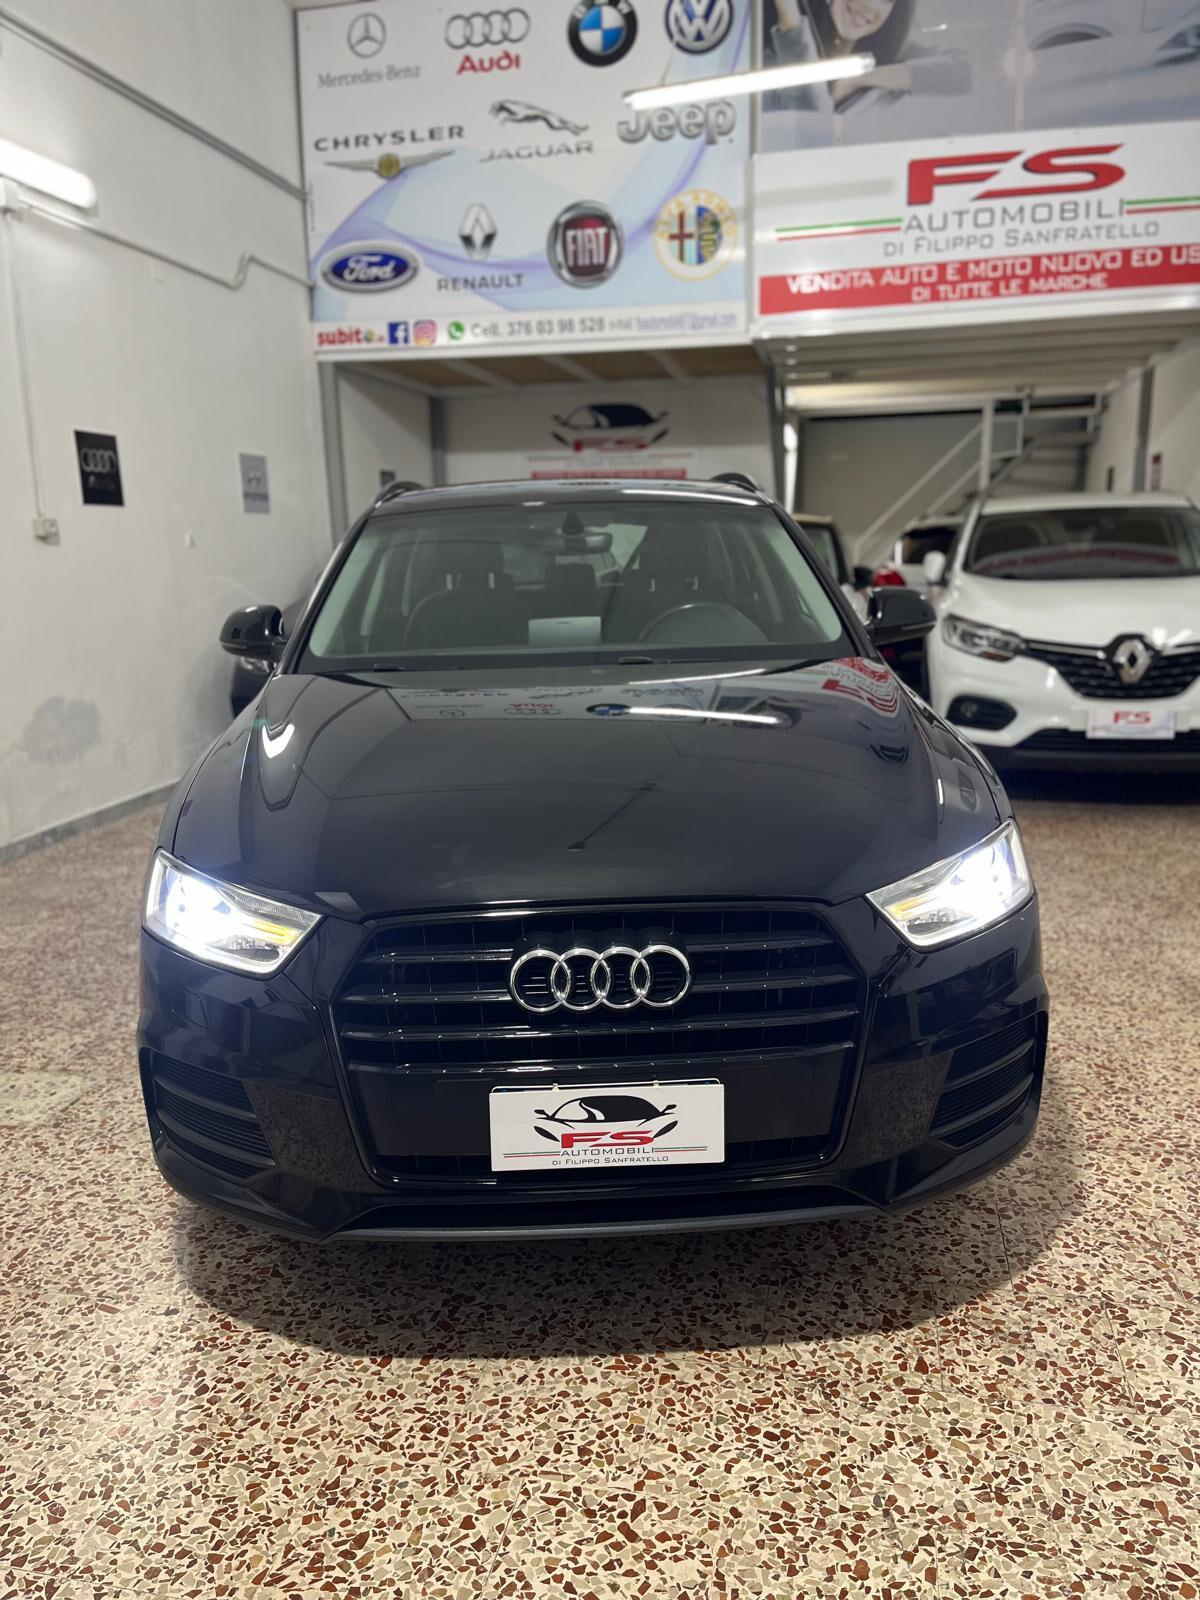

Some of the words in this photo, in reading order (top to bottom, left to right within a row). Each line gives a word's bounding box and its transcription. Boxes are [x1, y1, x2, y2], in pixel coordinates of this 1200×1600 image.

[317, 64, 422, 89] Mercedes-Benz
[457, 52, 522, 75] Audi
[617, 93, 737, 145] Jeep
[313, 125, 466, 152] CHRYSLER
[479, 141, 595, 164] JAGUAR
[906, 143, 1126, 206] FS
[903, 196, 1125, 234] AUTOMOBILI
[564, 227, 611, 268] FIAT
[883, 242, 905, 258] DI
[913, 233, 995, 256] FILIPPO
[1004, 220, 1160, 248] SANFRATELLO
[341, 253, 398, 283] Ford
[786, 270, 875, 295] VENDITA
[879, 264, 939, 286] AUTO
[946, 262, 961, 282] E
[967, 256, 1034, 280] MOTO
[1039, 250, 1124, 274] NUOVO
[1130, 246, 1164, 268] ED
[436, 273, 525, 294] RENAULT
[911, 287, 932, 303] DI
[936, 280, 994, 300] TUTTE
[998, 278, 1024, 296] LE
[1028, 271, 1110, 293] MARCHE
[560, 1147, 655, 1157] AUTOMOBILI
[561, 1130, 655, 1149] FS
[604, 1155, 669, 1164] SANFRATELLO
